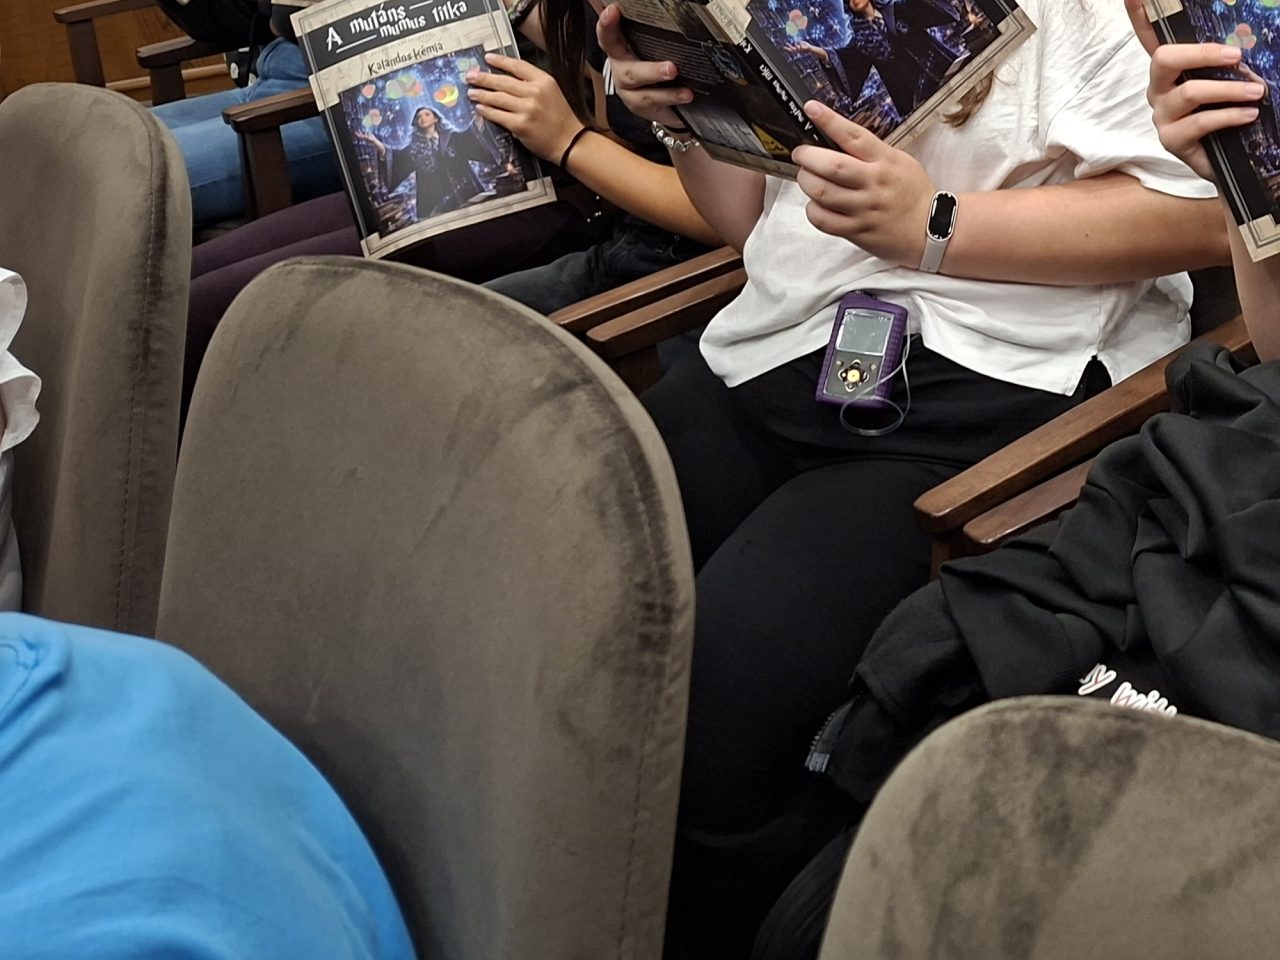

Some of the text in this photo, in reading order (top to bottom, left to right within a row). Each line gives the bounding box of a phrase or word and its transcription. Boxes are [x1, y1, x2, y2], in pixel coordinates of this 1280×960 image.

[326, 3, 406, 51] A mutáns
[379, 0, 467, 38] mumus titka
[368, 53, 412, 76] Kalandos
